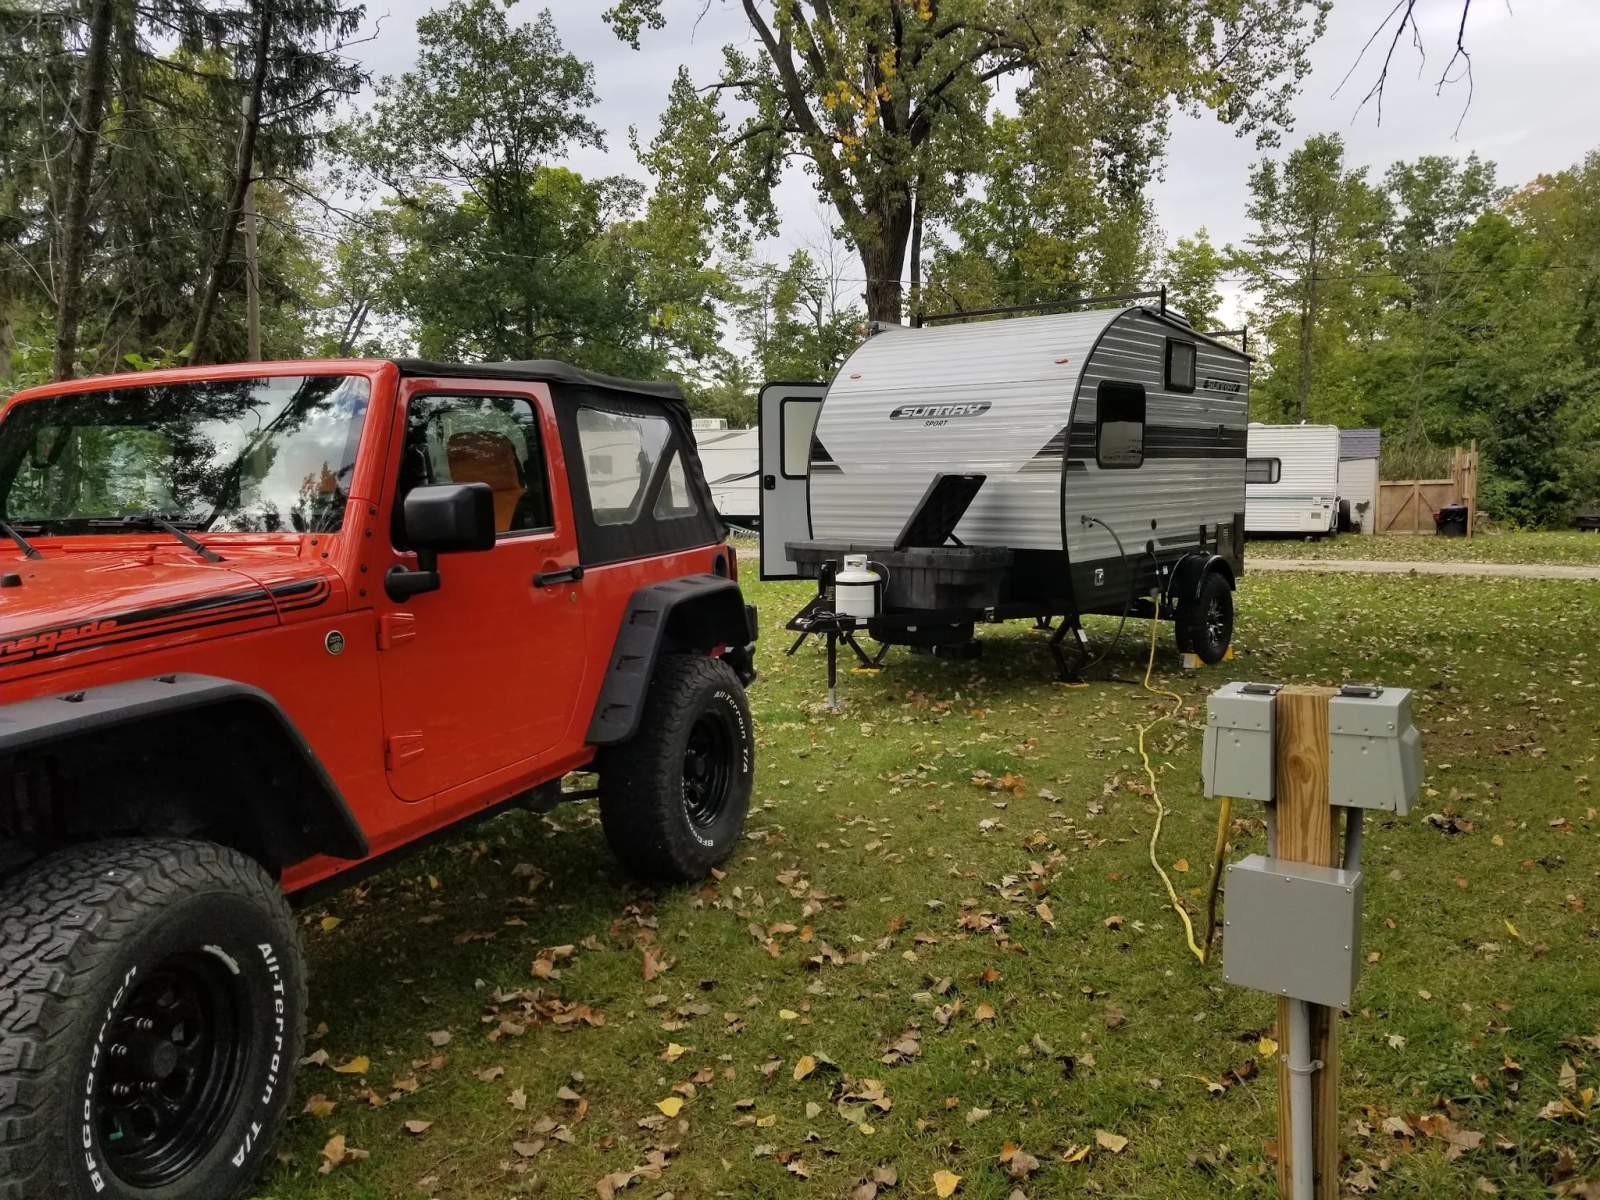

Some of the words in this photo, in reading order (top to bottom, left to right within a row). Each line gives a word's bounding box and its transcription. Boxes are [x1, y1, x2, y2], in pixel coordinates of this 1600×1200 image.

[899, 404, 983, 417] SUNRAY
[713, 690, 747, 739] All-Terrain
[258, 943, 284, 1104] All-Terrain
[82, 965, 137, 1193] BFGoodrich
[232, 1121, 262, 1168] T/A
